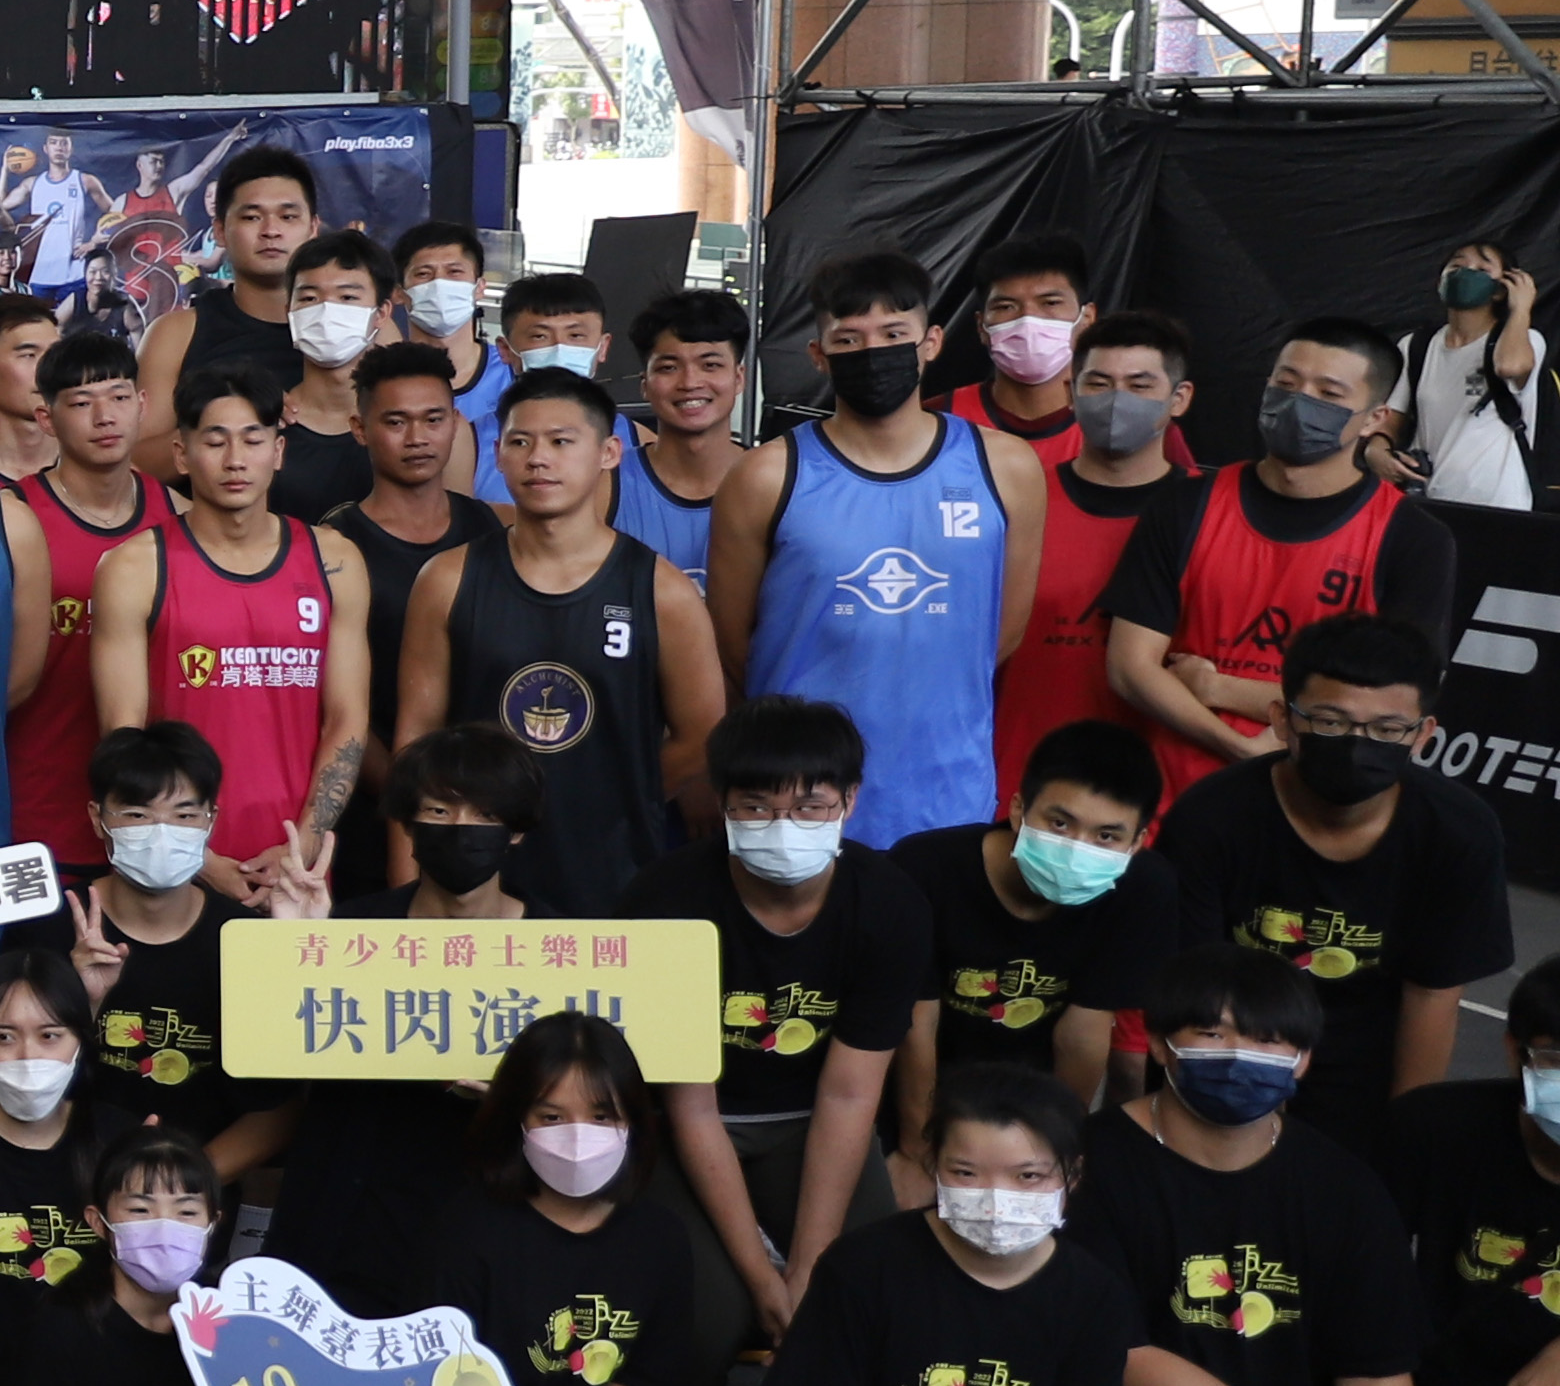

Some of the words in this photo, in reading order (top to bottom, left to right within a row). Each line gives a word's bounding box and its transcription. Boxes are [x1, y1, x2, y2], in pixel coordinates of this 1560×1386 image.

[324, 135, 413, 153] play.fiba3x3
[938, 501, 980, 538] 12
[1317, 568, 1366, 607] 91
[297, 597, 321, 634] 9
[220, 646, 320, 667] KENTUCKY
[603, 621, 632, 659] 3
[220, 667, 319, 689] 肯塔基美語
[295, 931, 631, 970] 青少年爵士樂團
[232, 1272, 451, 1370] 主舞臺表演
